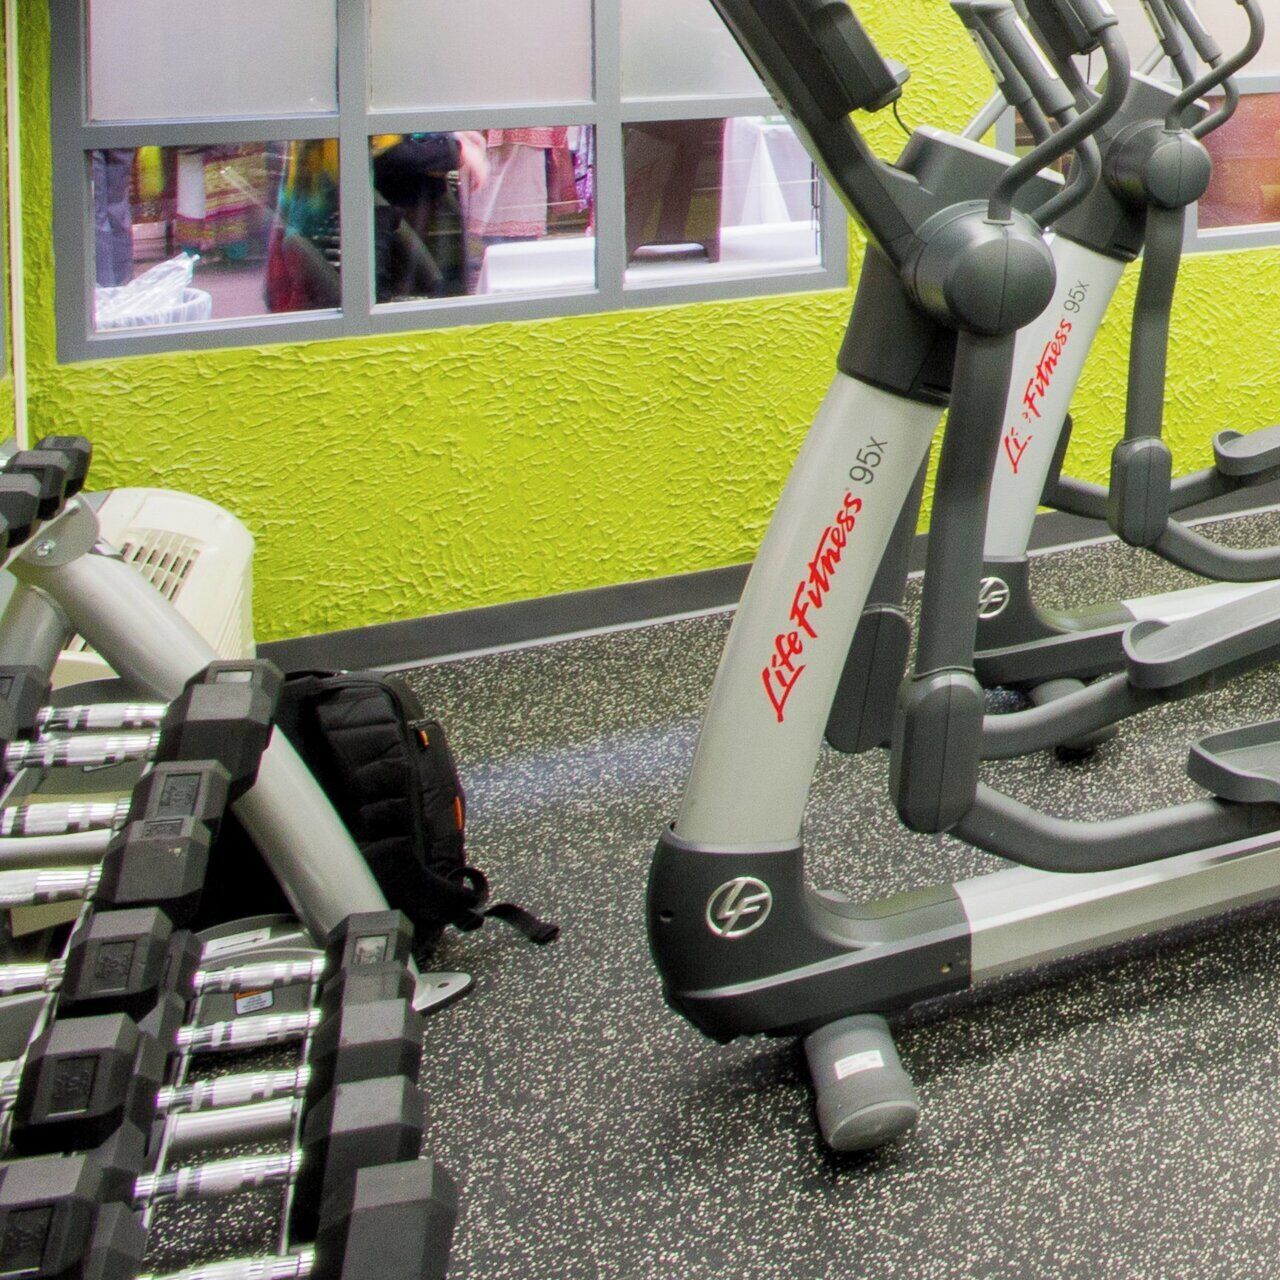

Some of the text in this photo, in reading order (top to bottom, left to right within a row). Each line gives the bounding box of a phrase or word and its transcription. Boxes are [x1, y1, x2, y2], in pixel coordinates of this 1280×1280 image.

[1063, 280, 1090, 314] 95x
[762, 436, 888, 723] Life Fitness 95x
